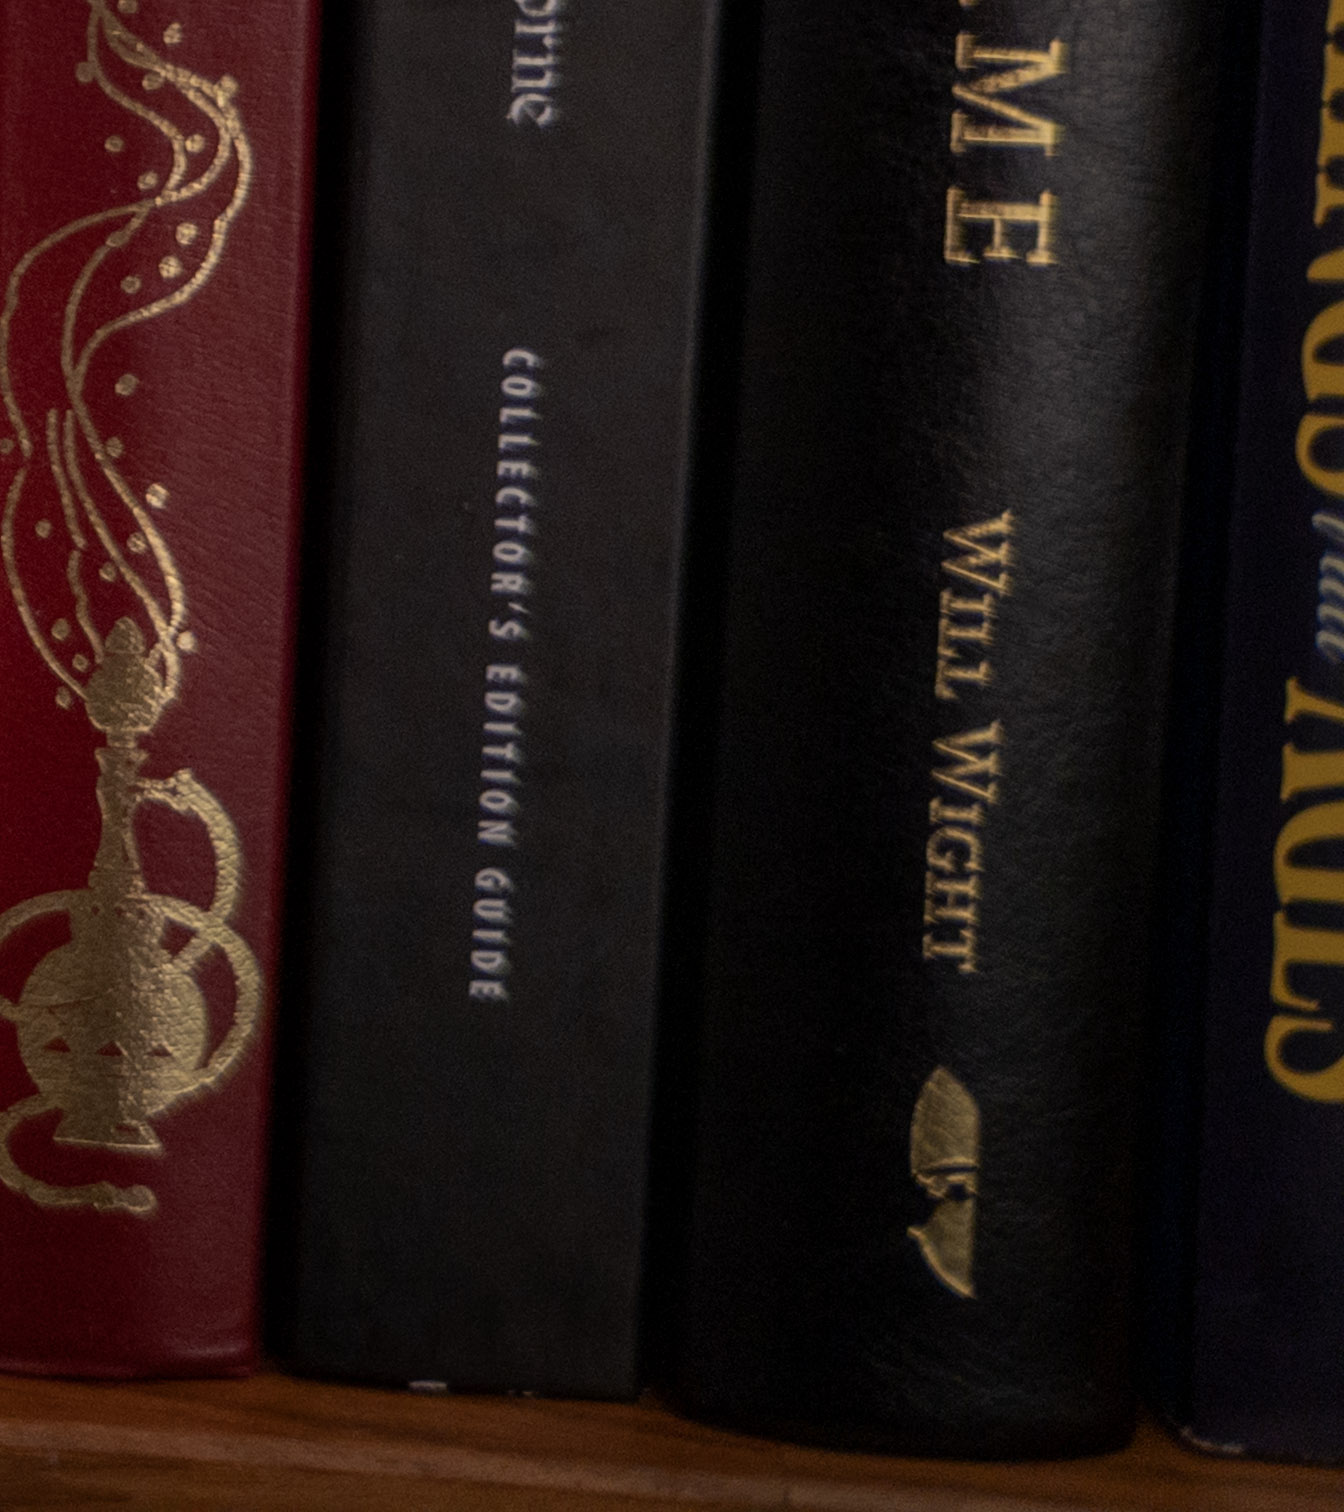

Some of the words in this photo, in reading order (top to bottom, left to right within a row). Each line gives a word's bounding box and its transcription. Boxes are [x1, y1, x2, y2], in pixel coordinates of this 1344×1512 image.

[486, 349, 539, 641] COLLECTOR'S
[934, 509, 1015, 701] WILL
[475, 664, 526, 846] EDITION
[922, 720, 1005, 975] WIGHT
[468, 867, 513, 1001] GUIDE
